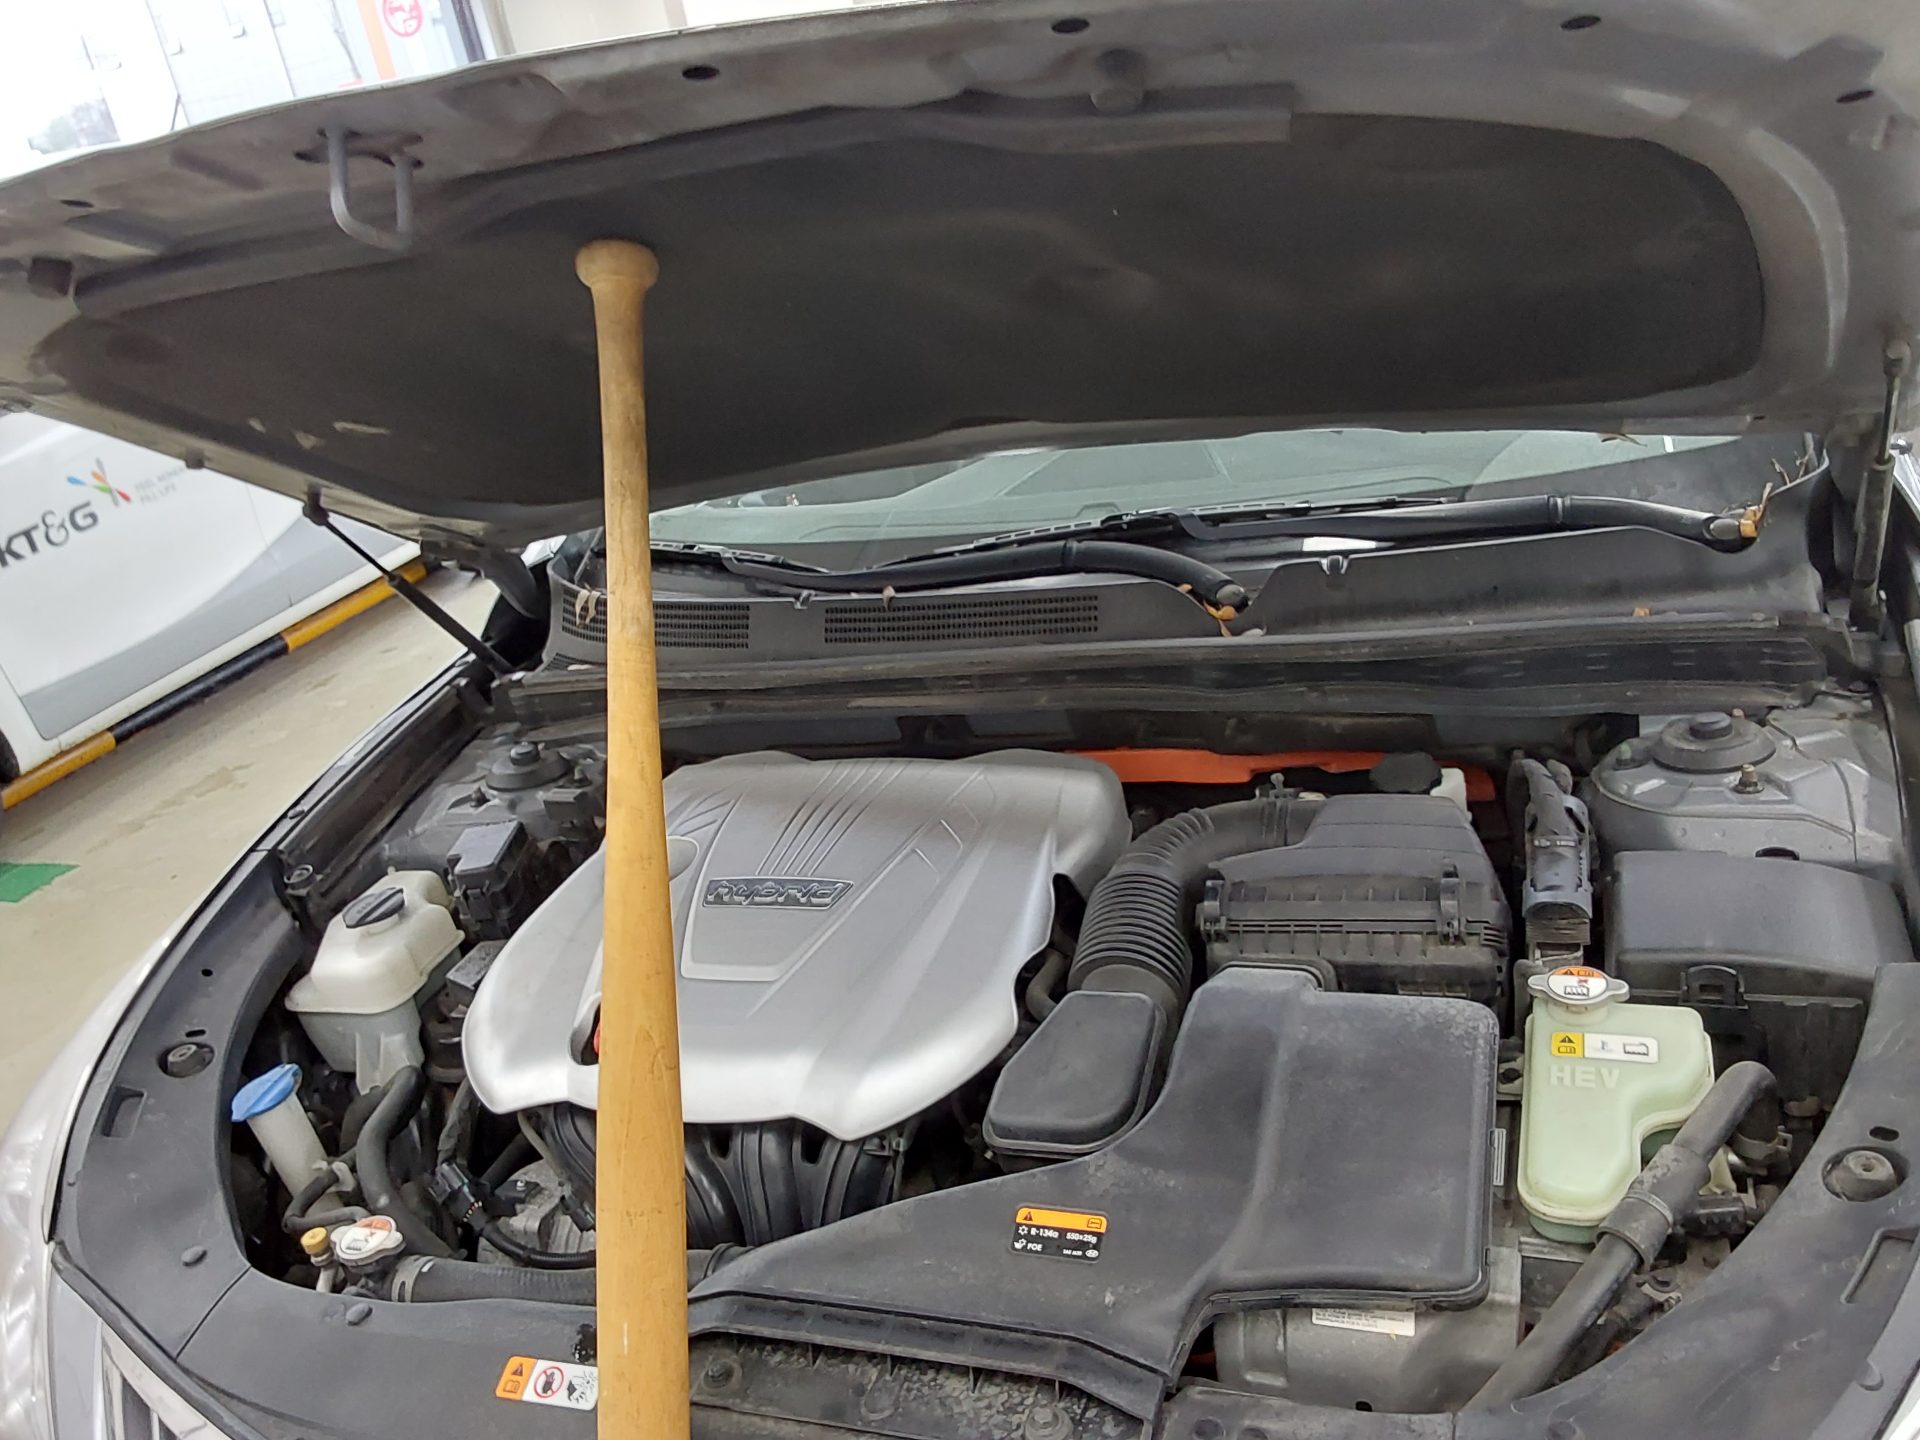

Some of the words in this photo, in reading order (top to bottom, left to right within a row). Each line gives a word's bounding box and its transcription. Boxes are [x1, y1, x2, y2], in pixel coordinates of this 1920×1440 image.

[0, 501, 98, 568] KT&G
[1549, 1064, 1620, 1089] HEV
[1030, 1228, 1059, 1239] R-134a
